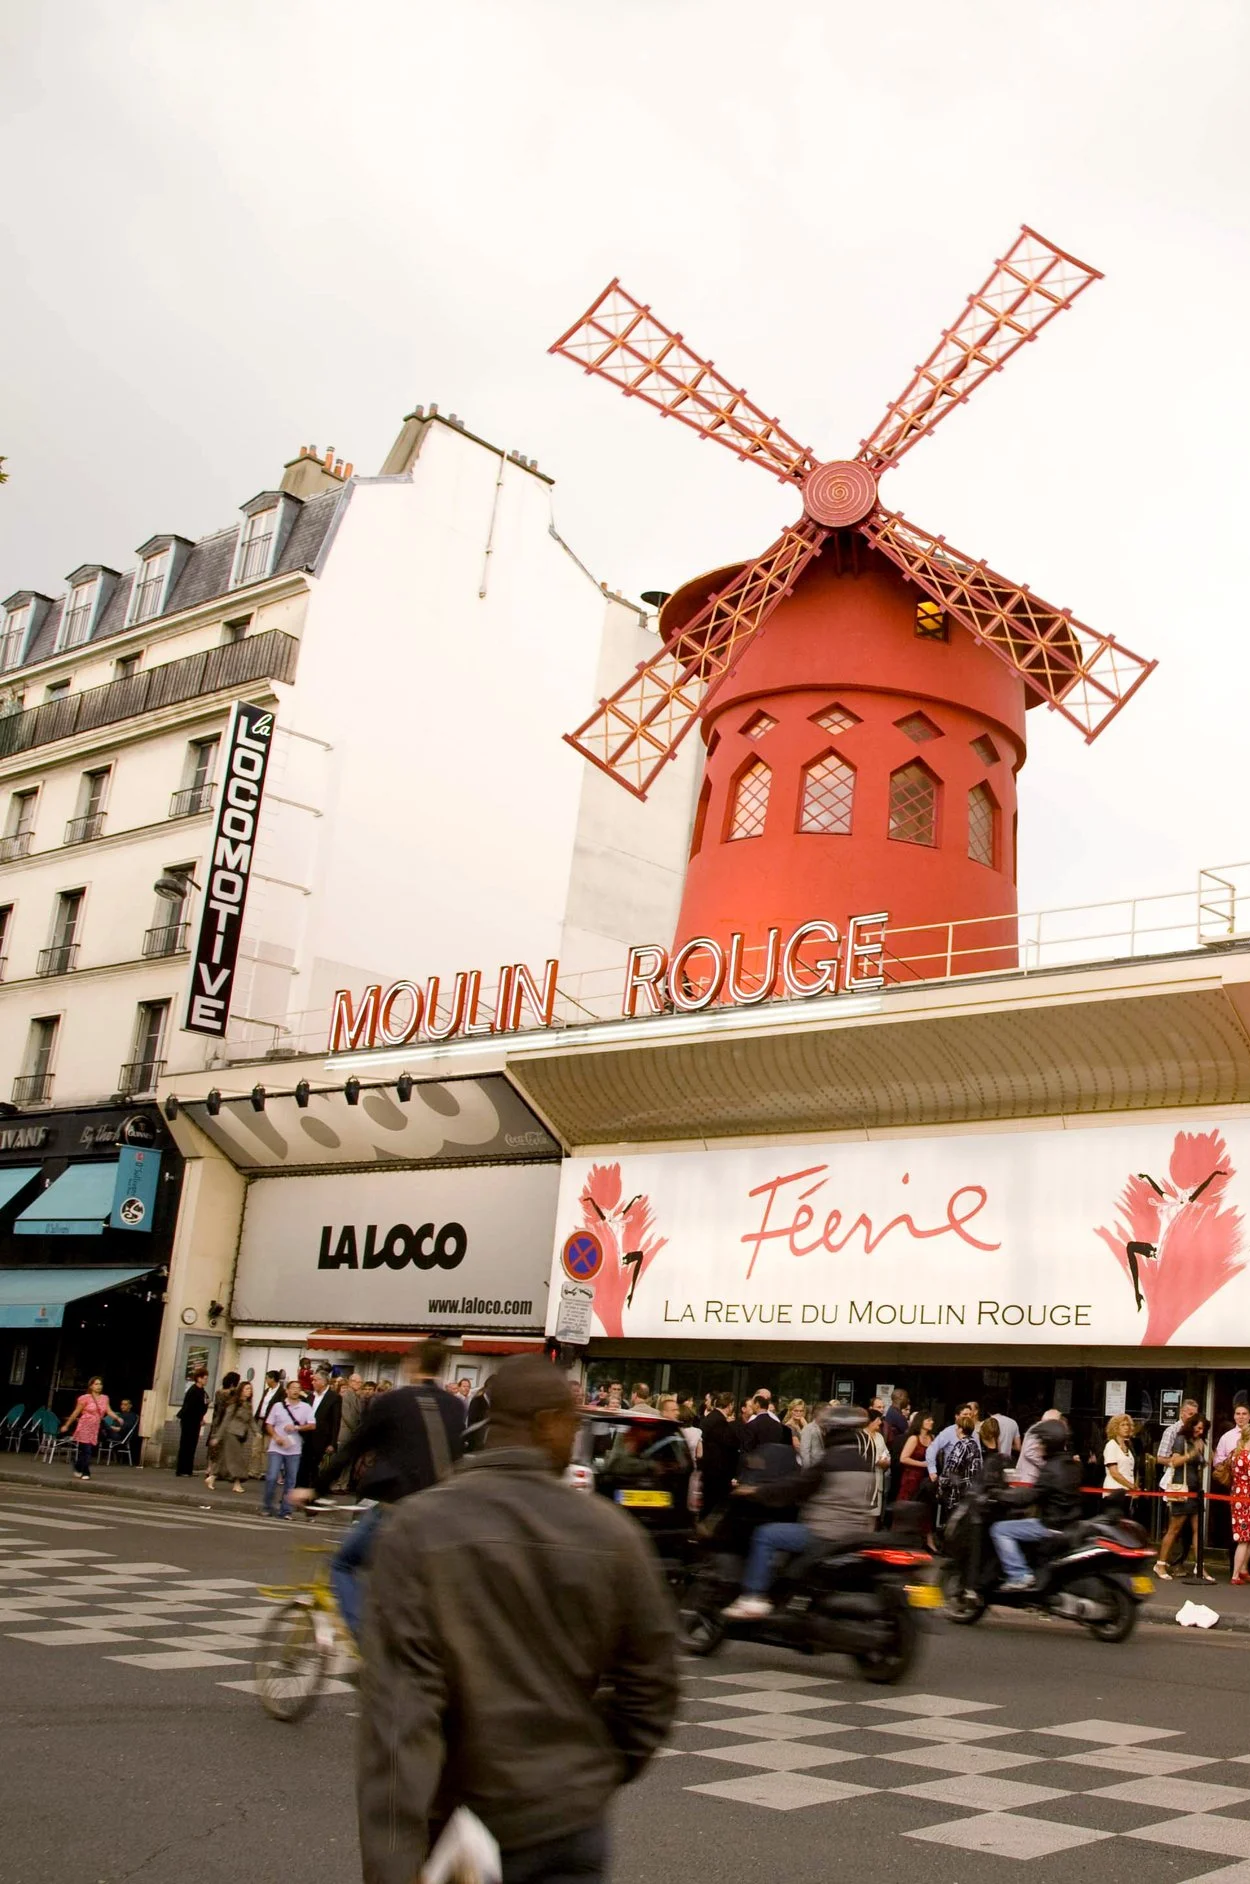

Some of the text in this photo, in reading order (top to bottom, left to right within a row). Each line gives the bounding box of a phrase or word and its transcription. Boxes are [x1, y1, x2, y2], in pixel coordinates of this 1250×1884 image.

[251, 714, 271, 737] la
[190, 715, 266, 1031] LOCOMOTIVE
[327, 912, 891, 1051] MOULIN ROUGE
[362, 1221, 468, 1270] LOCO
[741, 1163, 1002, 1280] Féerie
[428, 1297, 533, 1316] www.laloco.com
[663, 1300, 696, 1323] LA
[703, 1300, 793, 1324] REVUE
[848, 1300, 967, 1326] MOULIN
[977, 1300, 1093, 1327] ROUGE
